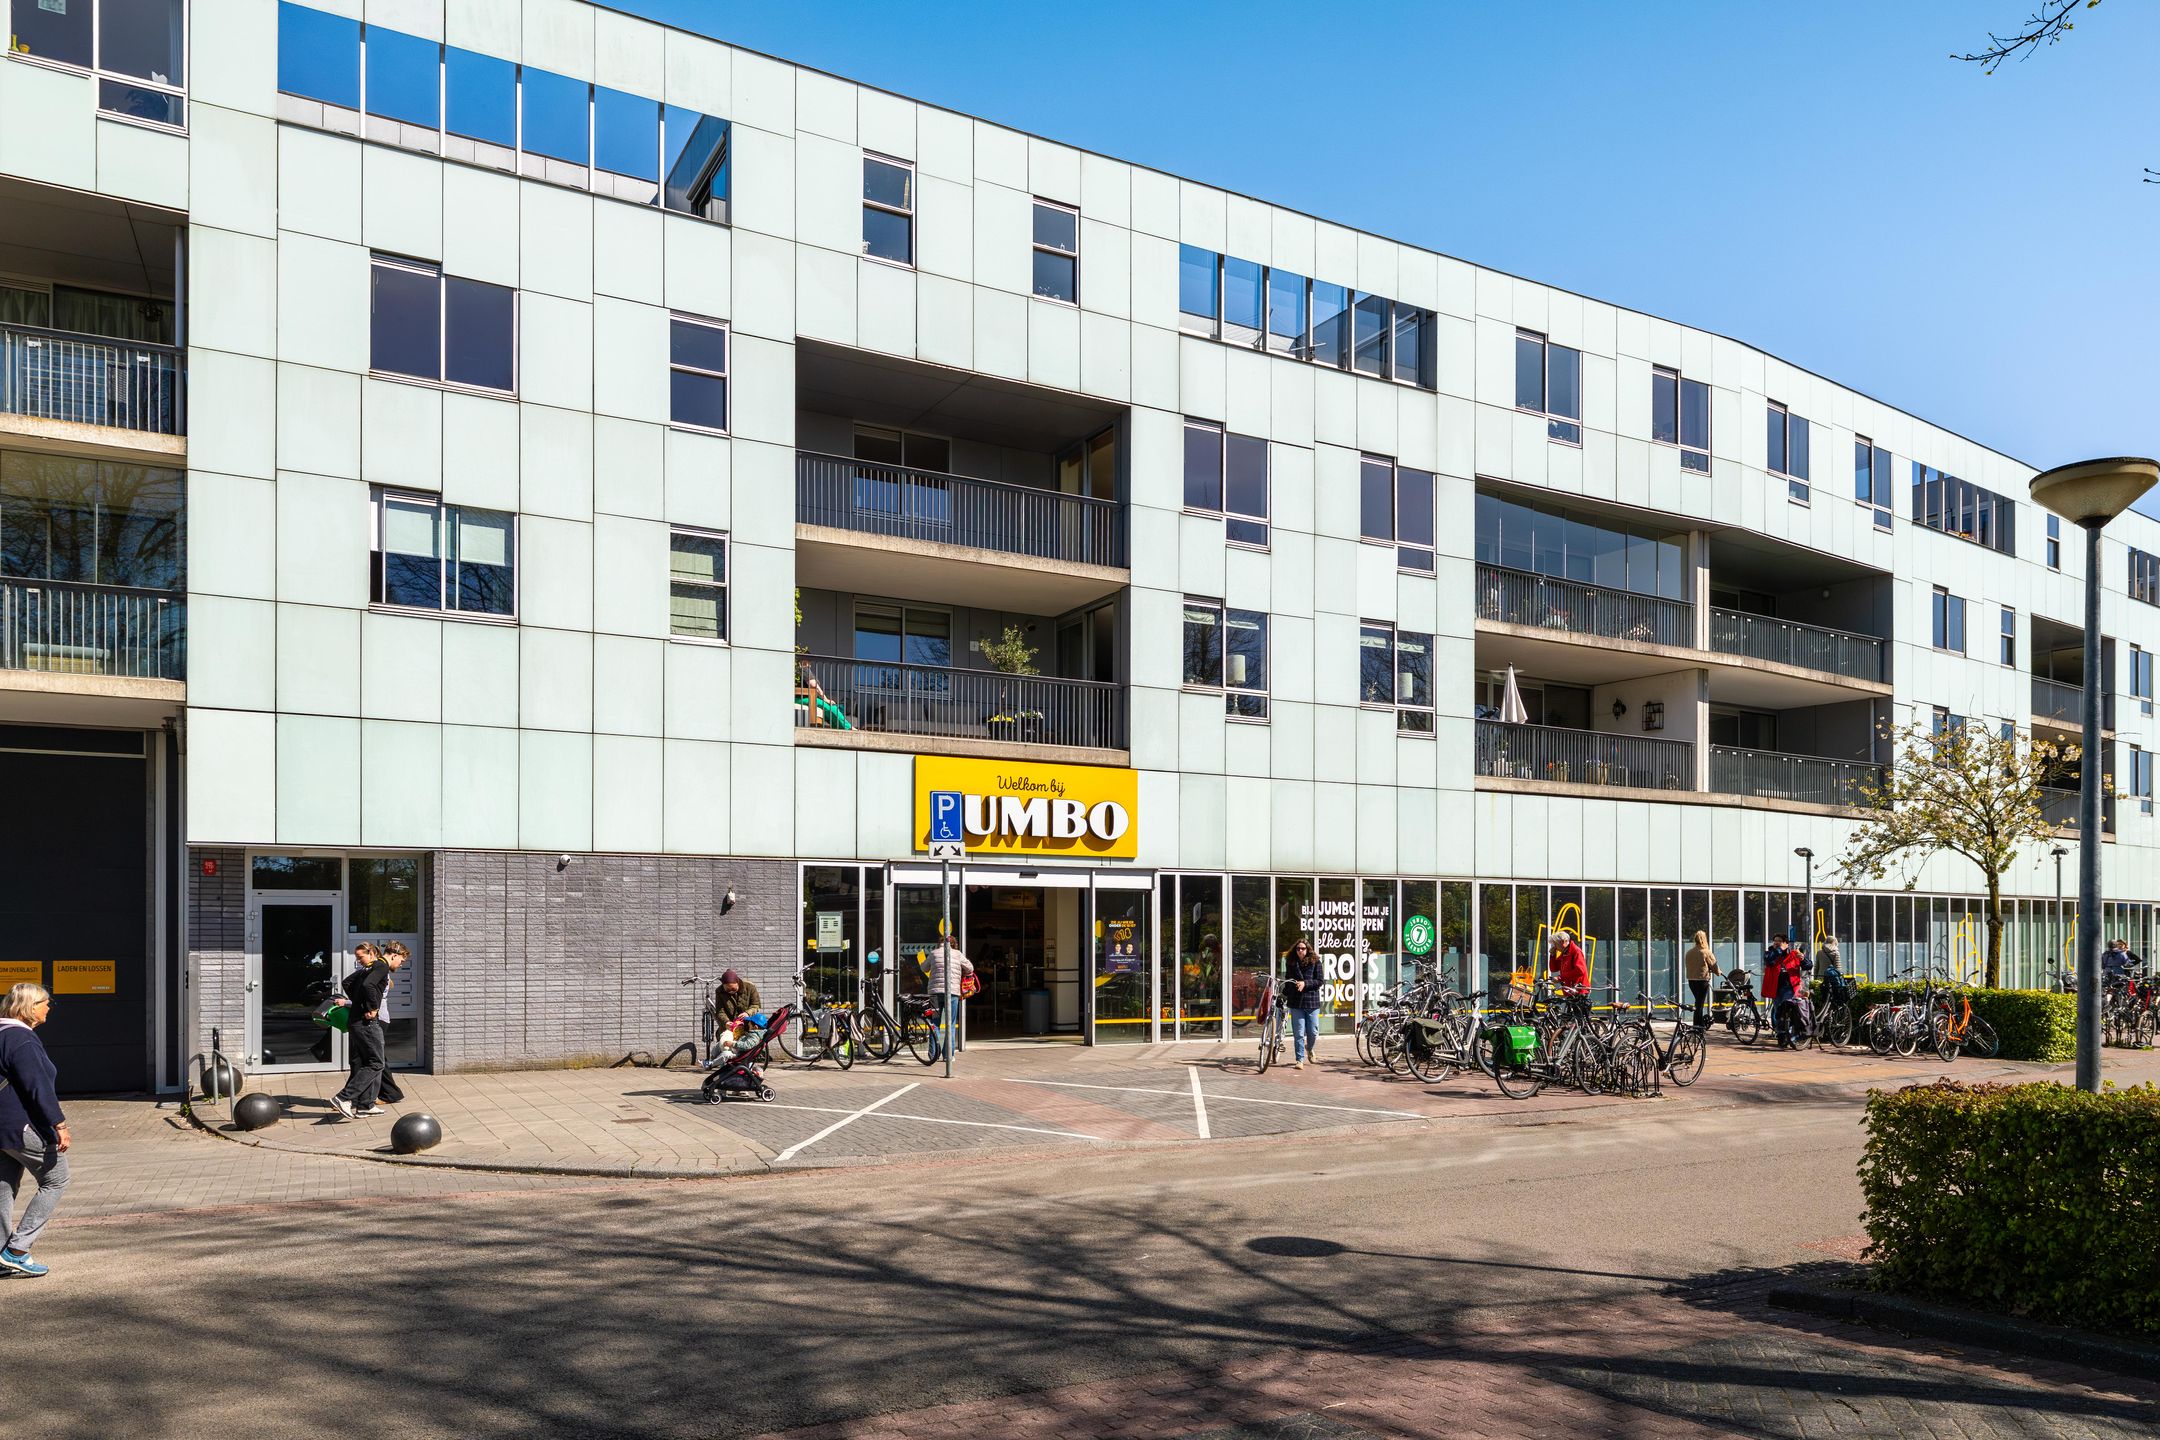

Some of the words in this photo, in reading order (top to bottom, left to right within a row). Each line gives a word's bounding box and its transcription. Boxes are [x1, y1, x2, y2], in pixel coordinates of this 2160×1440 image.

[997, 775, 1049, 791] Welkom
[1050, 779, 1066, 797] bij
[938, 795, 955, 820] P
[964, 794, 1129, 841] UMBO
[1301, 905, 1314, 916] BIJ
[1318, 900, 1356, 916] JUMBO
[1363, 906, 1380, 916] ZIJN
[1380, 906, 1389, 916] JE
[1318, 932, 1342, 949] elke
[1416, 928, 1423, 942] 7
[57, 965, 78, 973] LADEN
[79, 965, 88, 973] EN
[88, 965, 112, 973] LOSSEN
[1319, 953, 1379, 981] RO'S
[1319, 983, 1385, 1002] EDKOPER
